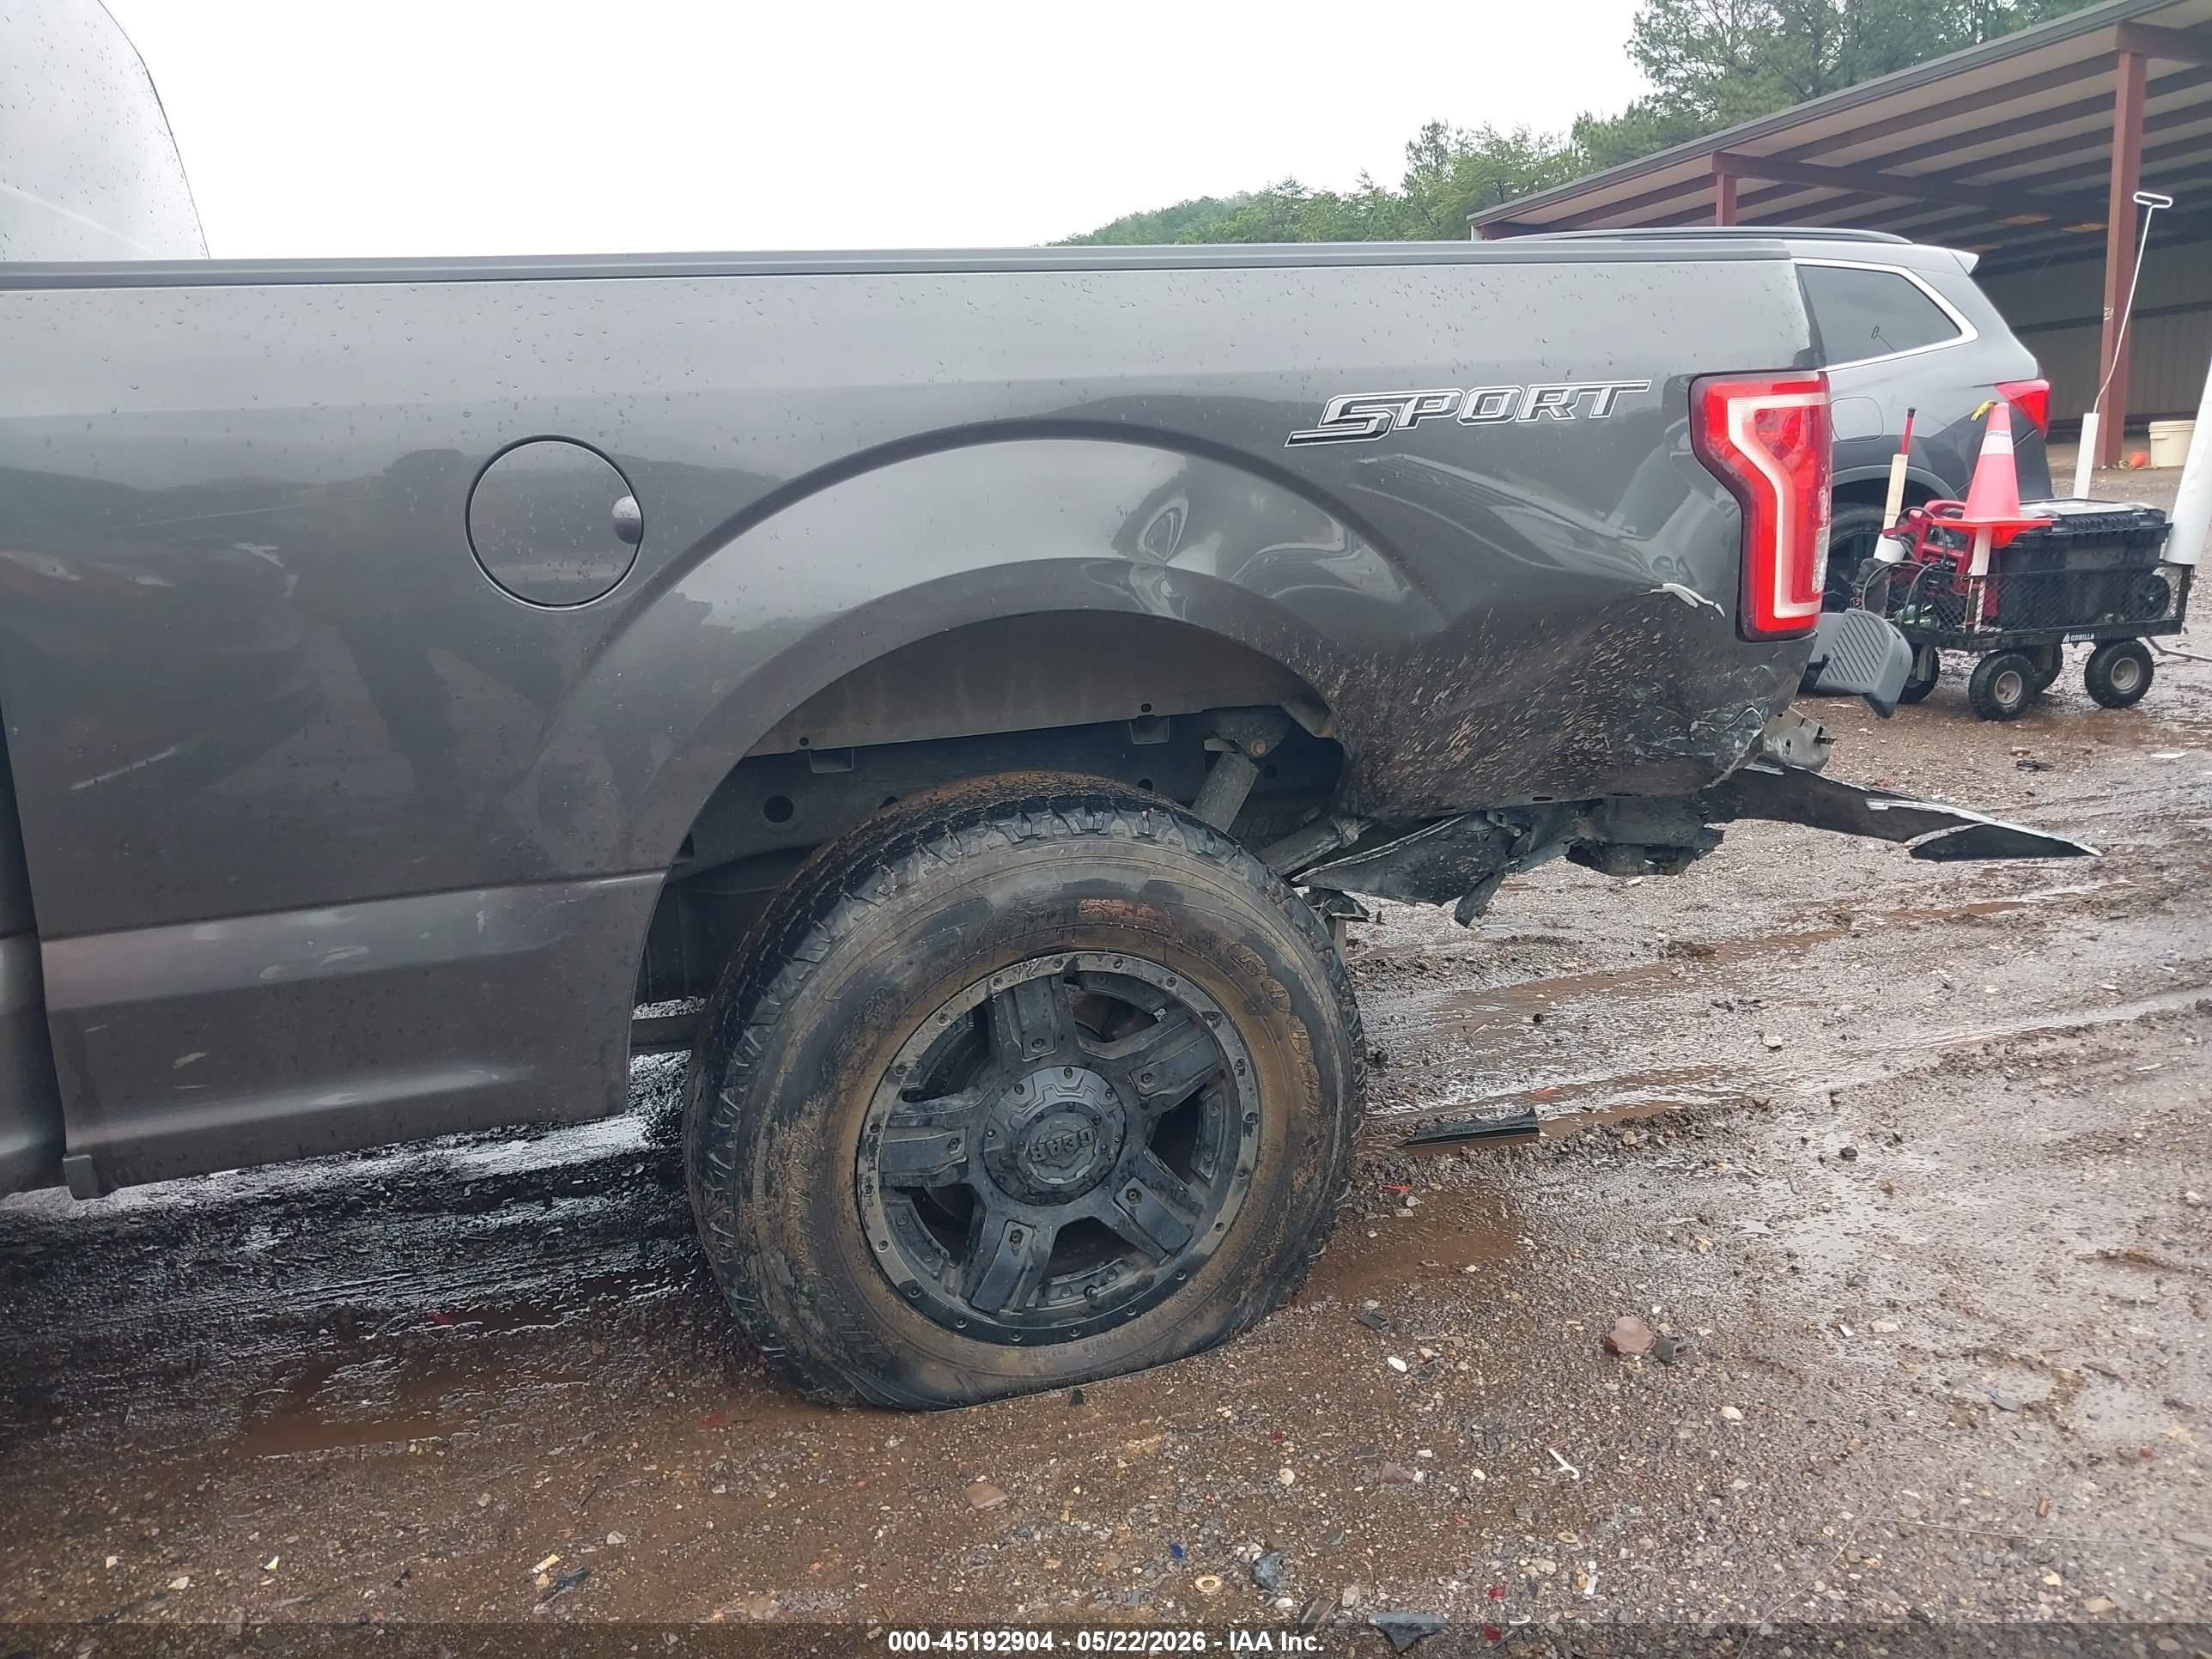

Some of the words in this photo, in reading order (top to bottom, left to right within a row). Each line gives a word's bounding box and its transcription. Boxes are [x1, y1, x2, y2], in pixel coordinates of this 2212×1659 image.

[1284, 379, 1652, 448] SPORT
[2070, 633, 2095, 641] GORILLA
[1030, 1127, 1095, 1162] GEAR
